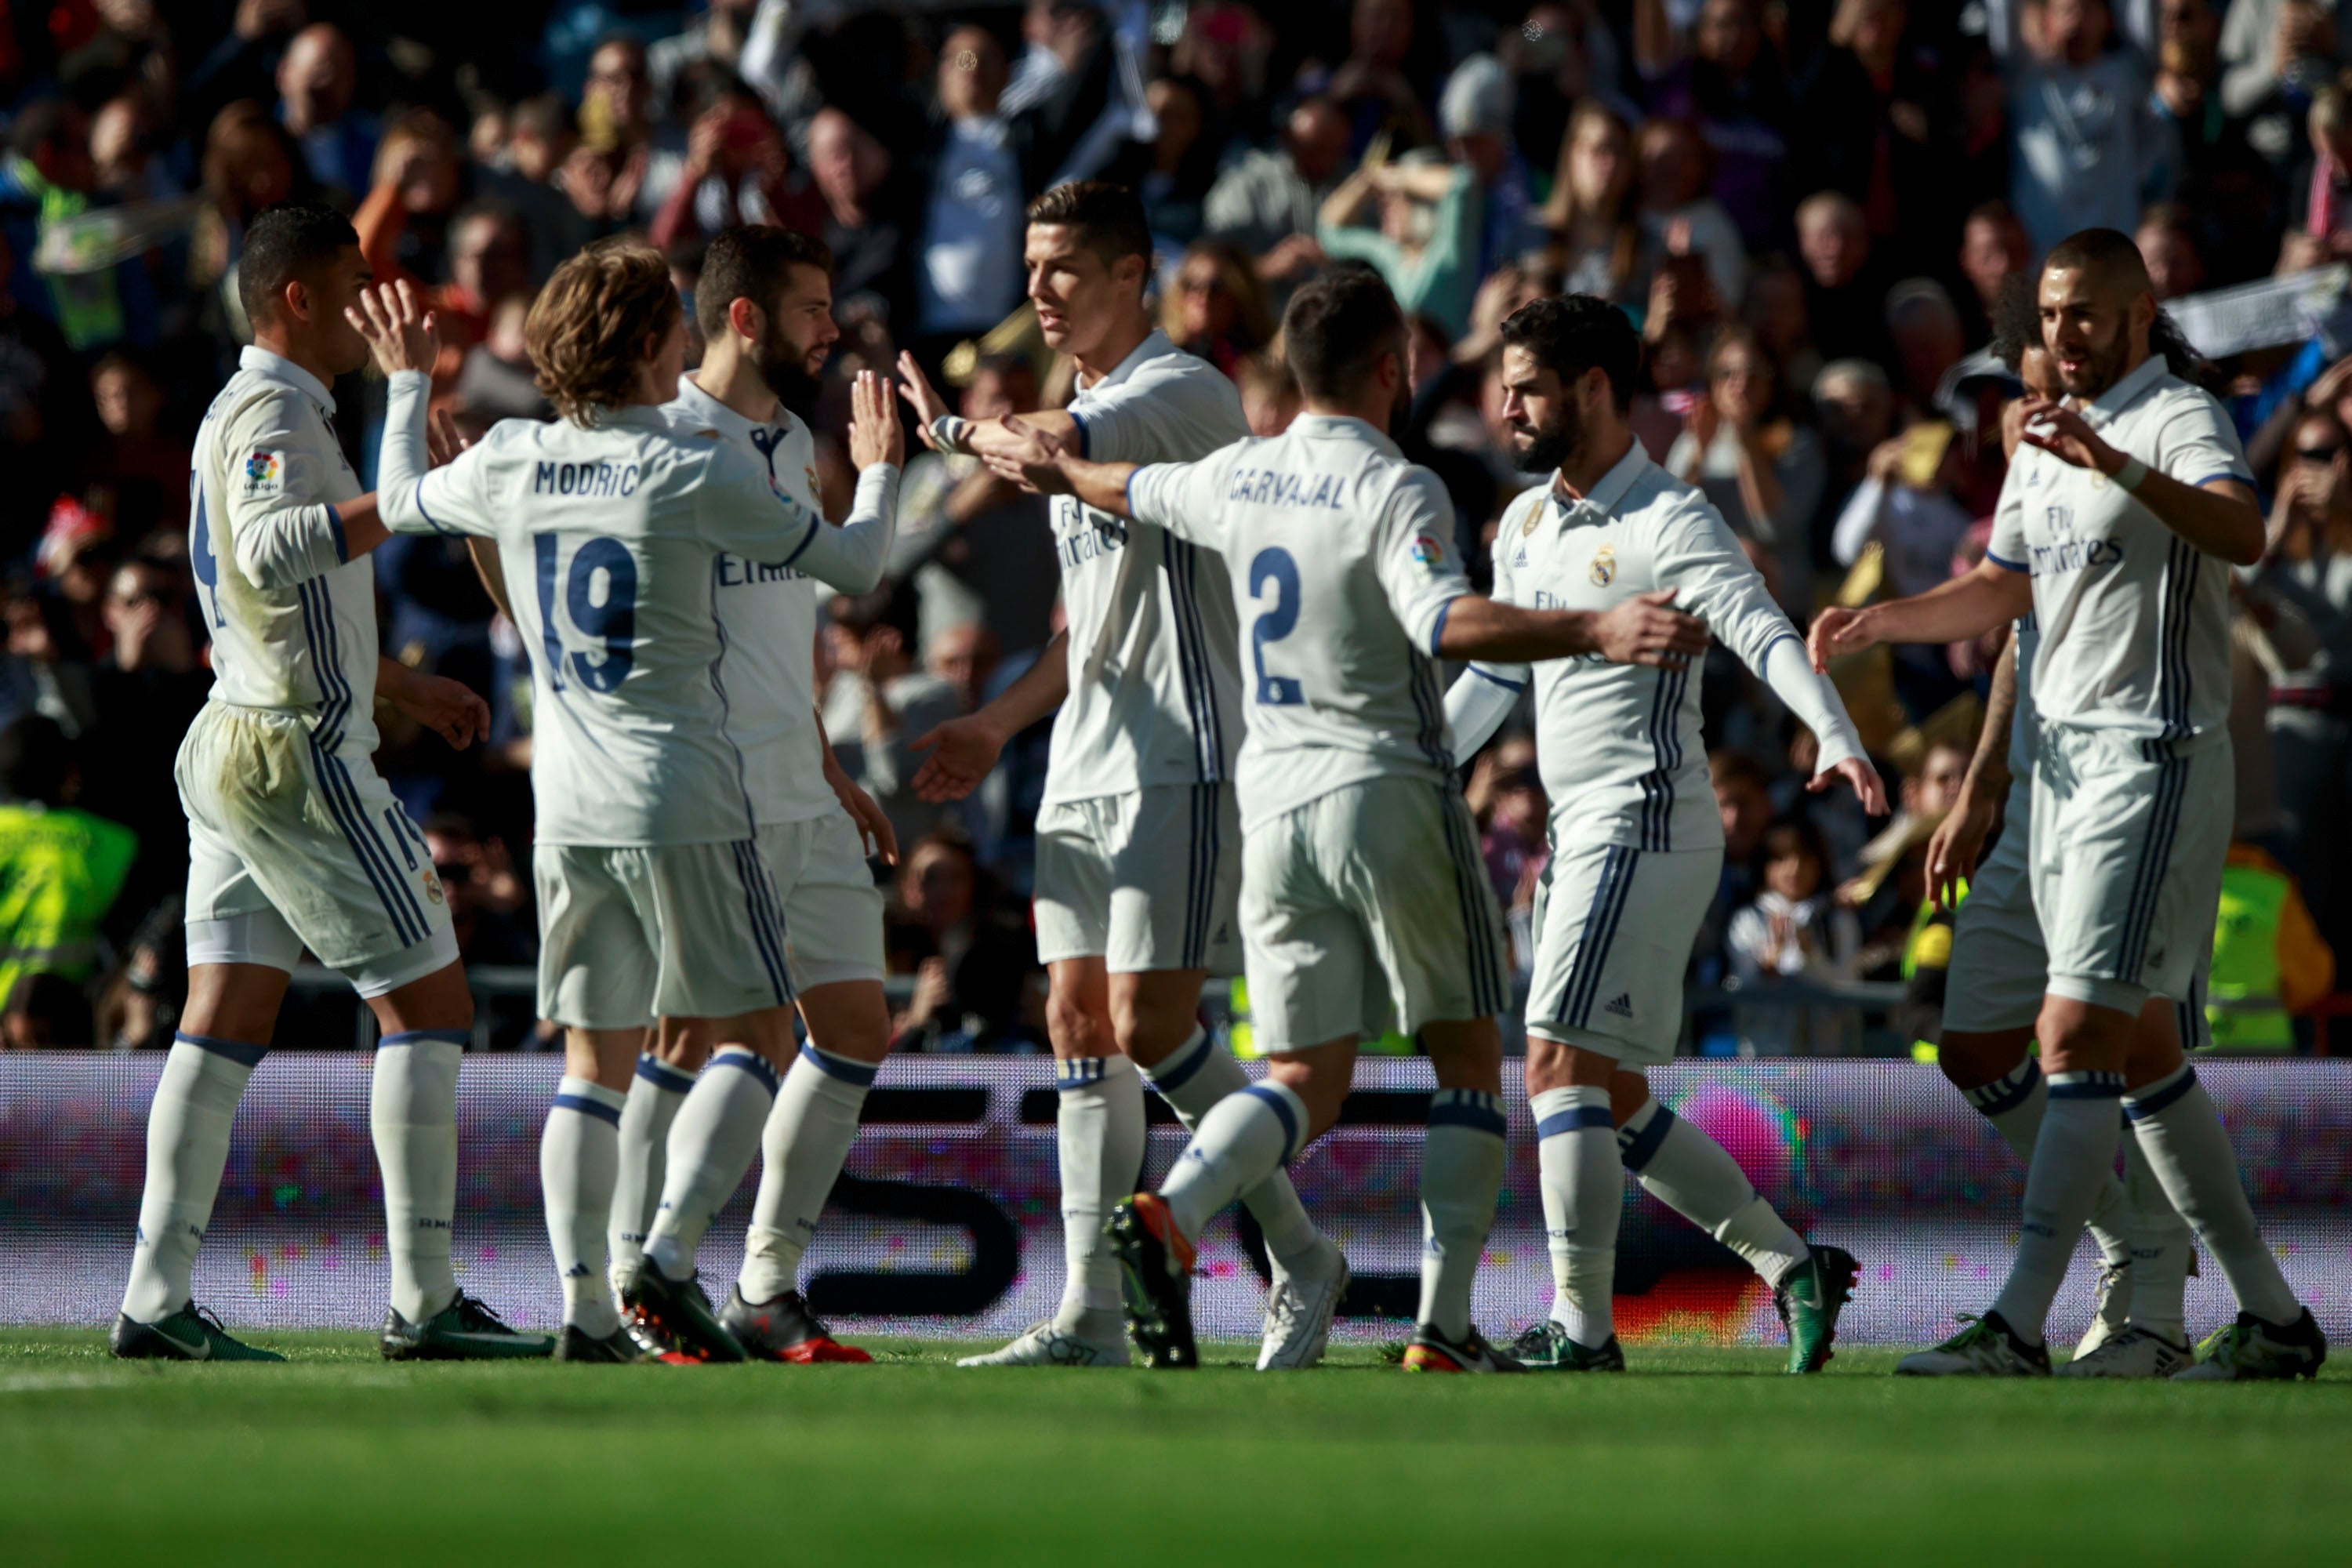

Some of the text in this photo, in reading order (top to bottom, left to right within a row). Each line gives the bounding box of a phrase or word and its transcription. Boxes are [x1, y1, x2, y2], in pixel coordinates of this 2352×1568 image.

[1229, 469, 1346, 510] CARVAJAL
[533, 532, 637, 695] 19
[1249, 546, 1305, 705] 2
[1048, 1338, 1098, 1367] CR7
